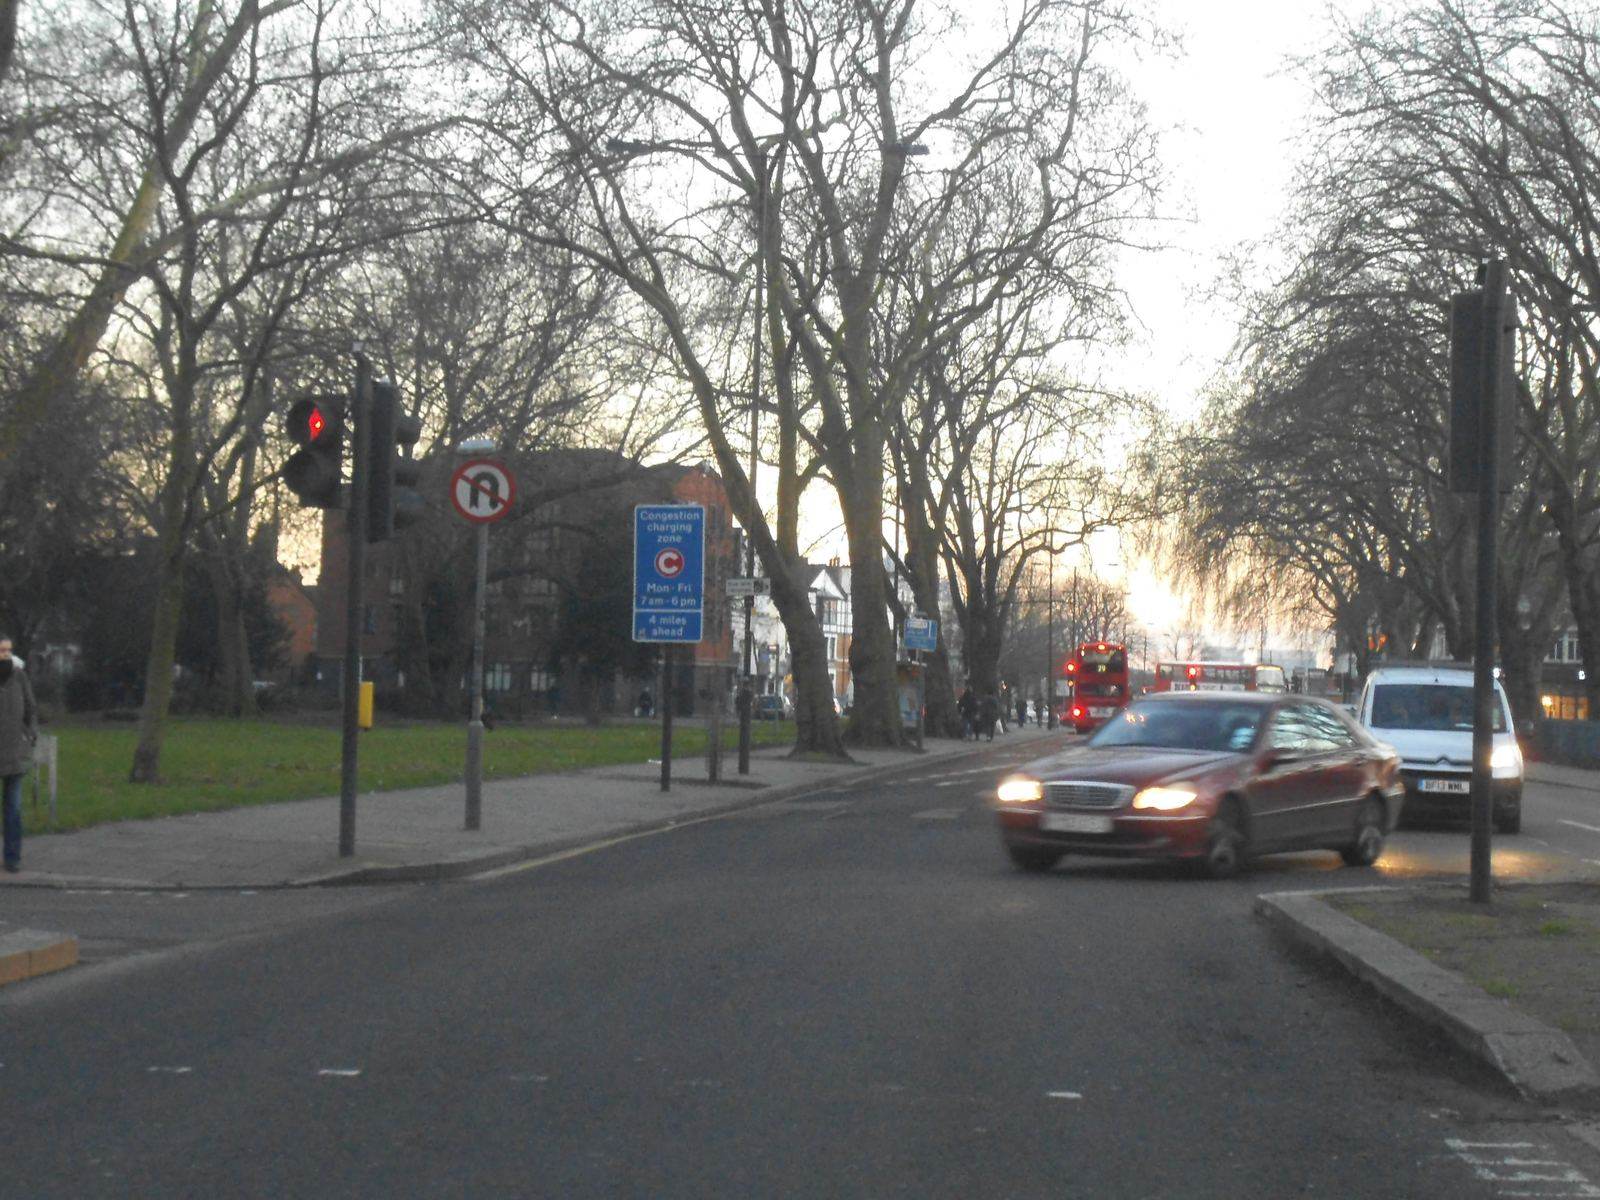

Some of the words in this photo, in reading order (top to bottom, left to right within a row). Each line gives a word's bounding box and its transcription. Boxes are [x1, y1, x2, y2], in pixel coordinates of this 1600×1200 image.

[640, 511, 700, 523] Congestion
[647, 523, 692, 534] charging
[657, 534, 682, 543] zone
[658, 551, 679, 575] C
[646, 583, 669, 593] Mon
[678, 583, 692, 593] Fri
[648, 615, 656, 625] 4
[660, 615, 687, 625] miles
[652, 627, 683, 637] ahead
